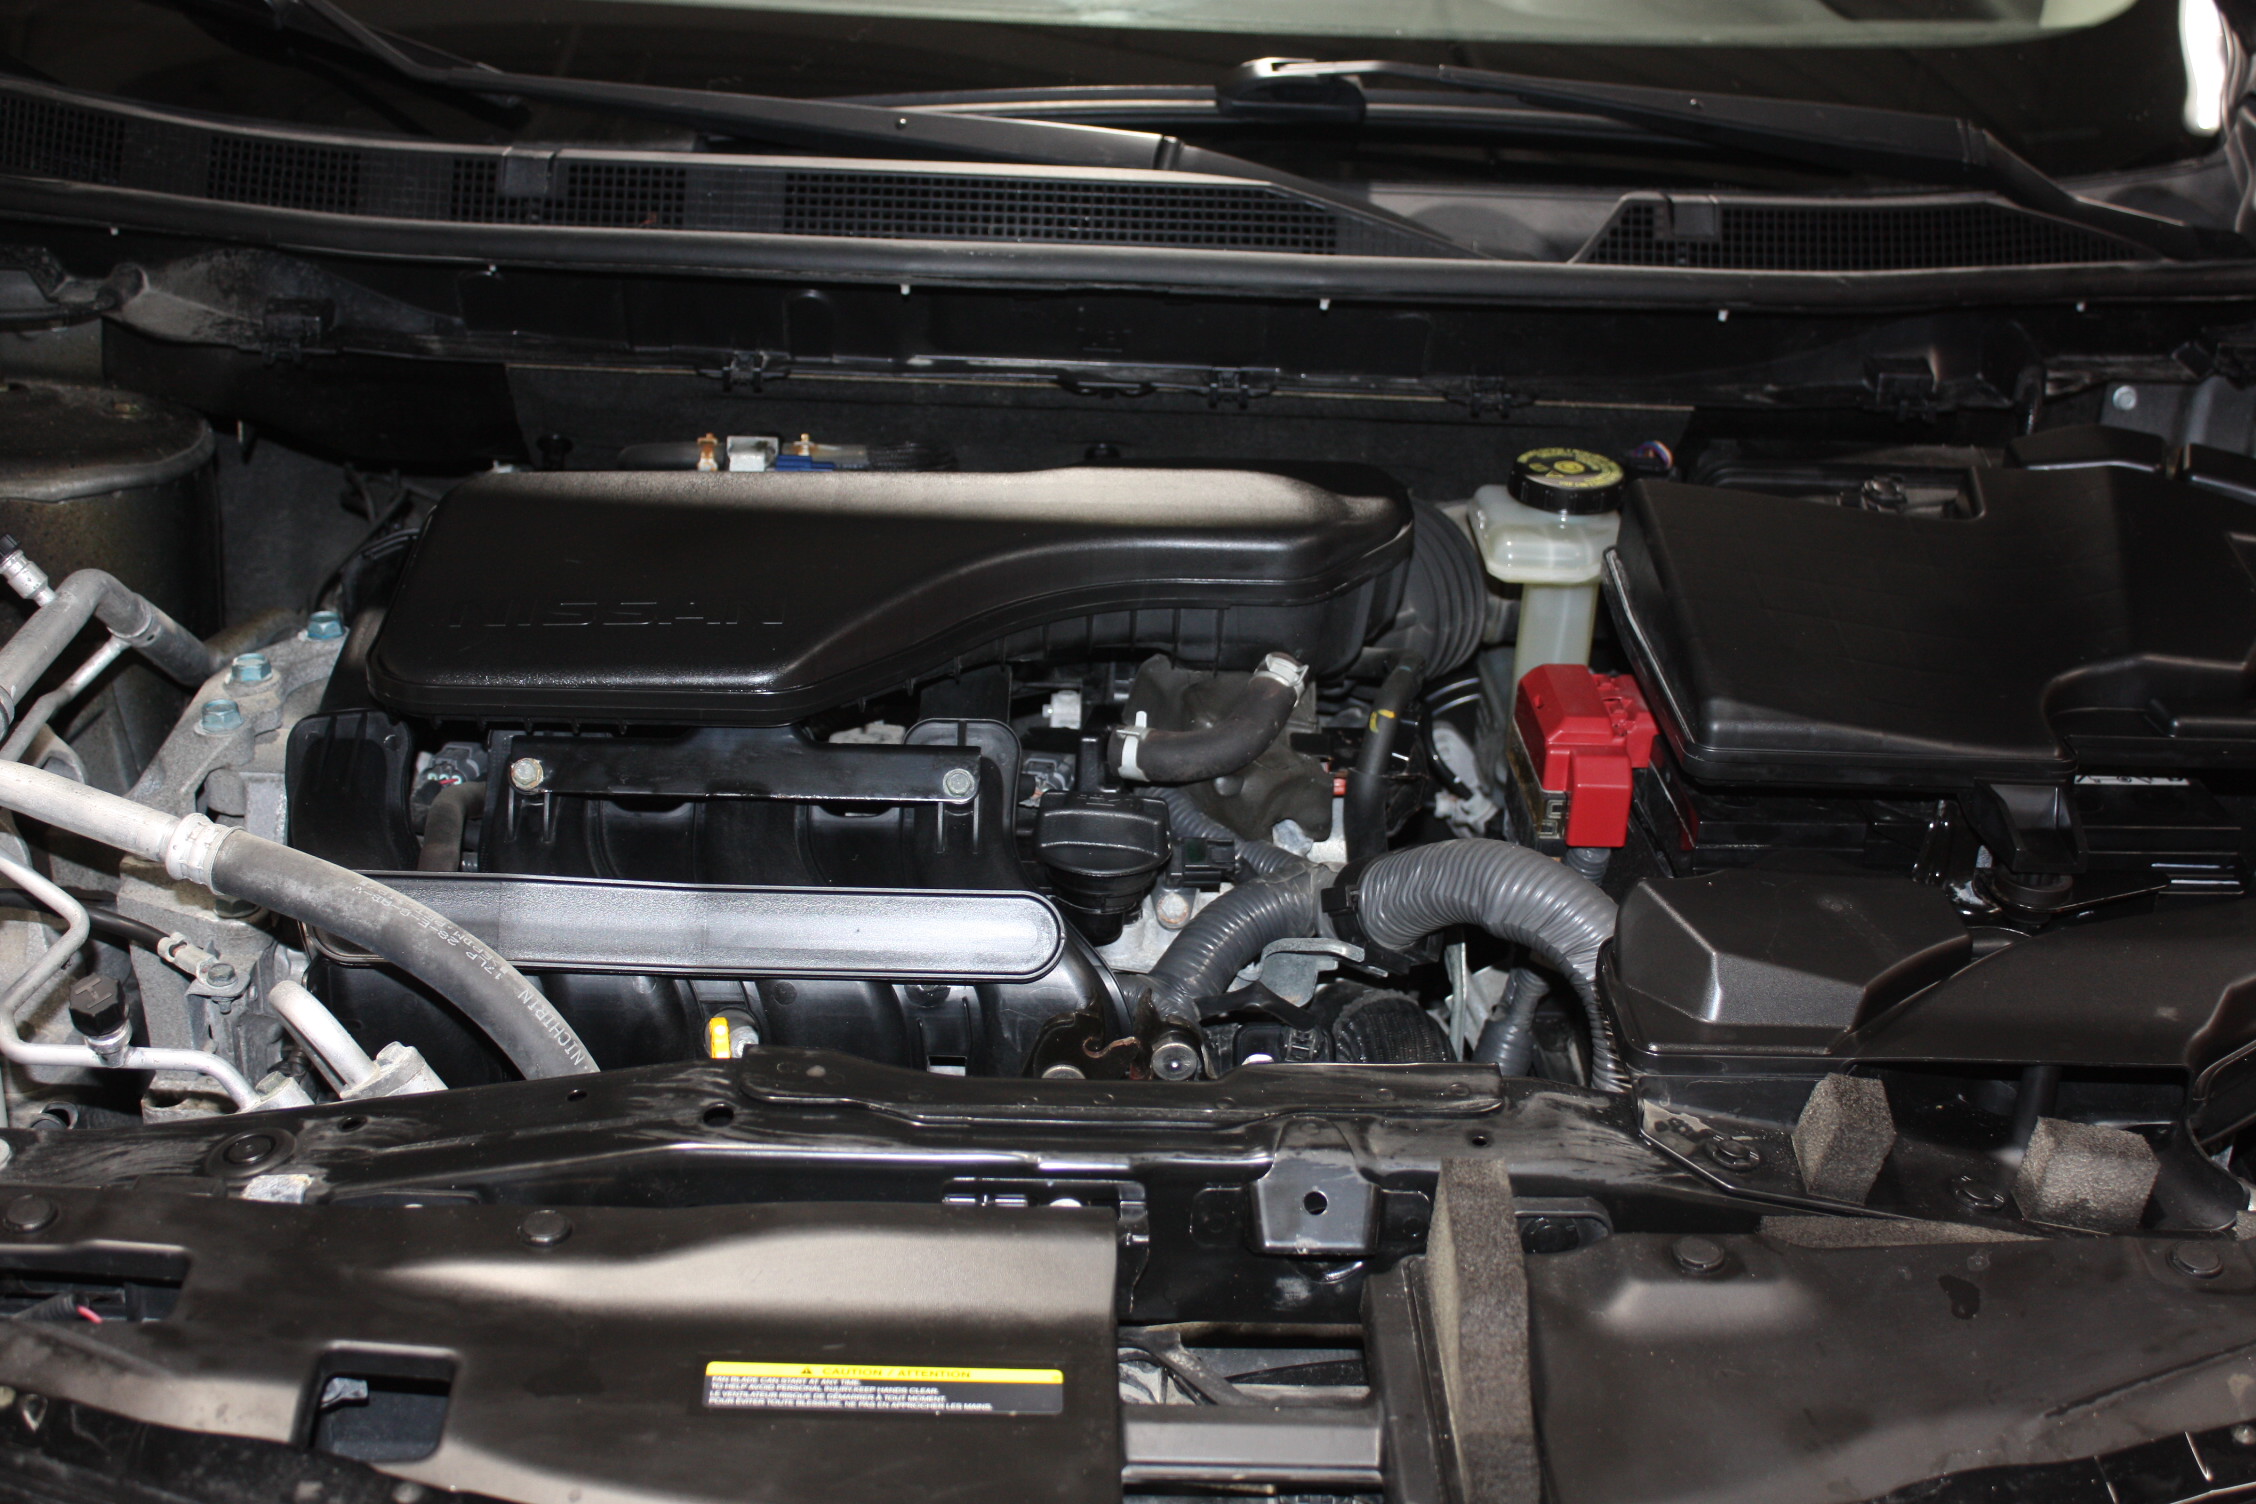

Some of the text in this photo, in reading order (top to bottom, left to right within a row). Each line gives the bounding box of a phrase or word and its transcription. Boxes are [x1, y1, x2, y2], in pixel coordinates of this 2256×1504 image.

[449, 600, 785, 628] NISSAN
[465, 950, 502, 980] 17LP
[517, 989, 586, 1066] NICHIRIN
[823, 1367, 882, 1376] CAUTION
[898, 1369, 970, 1378] ATTENTION
